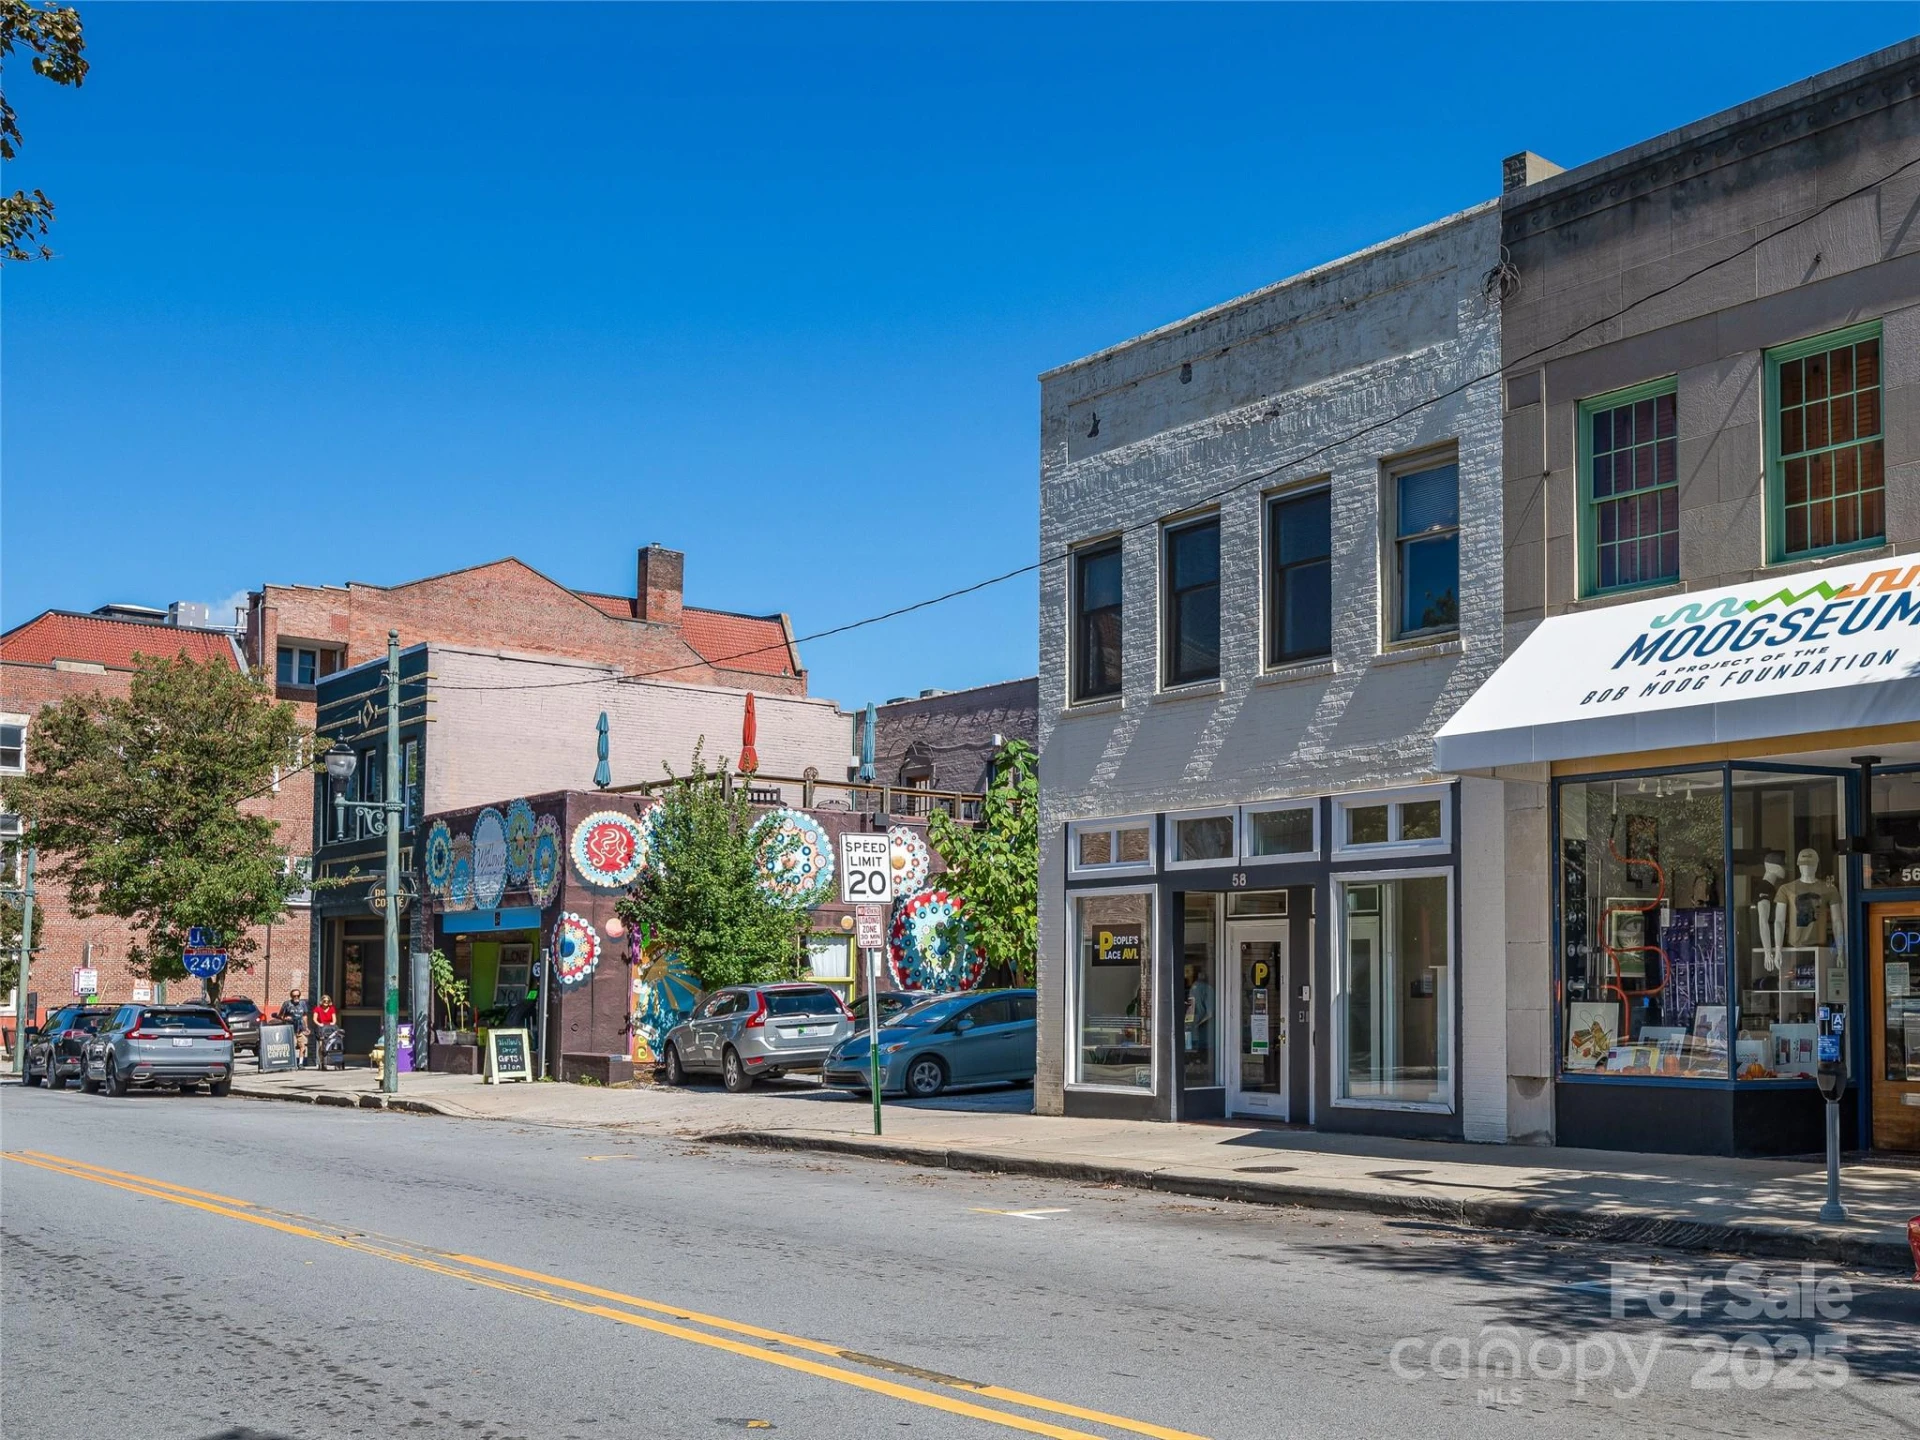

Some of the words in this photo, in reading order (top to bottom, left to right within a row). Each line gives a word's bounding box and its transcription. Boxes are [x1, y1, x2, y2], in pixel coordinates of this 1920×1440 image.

[1611, 591, 1920, 670] MOOGSEUM
[1656, 669, 1667, 677] A
[1675, 657, 1754, 675] PROJECT
[1761, 652, 1785, 662] OF
[1794, 646, 1829, 658] THE
[1580, 686, 1629, 706] BOB
[1639, 675, 1709, 697] MOOG
[1719, 649, 1899, 687] FOUNDATION
[845, 842, 886, 853] SPEED
[850, 856, 882, 866] LIMIT
[1232, 873, 1246, 886] 58
[1902, 868, 1920, 881] 56
[848, 870, 886, 895] 20
[862, 925, 877, 933] ZONE
[190, 957, 221, 970] 240
[1255, 962, 1268, 986] P
